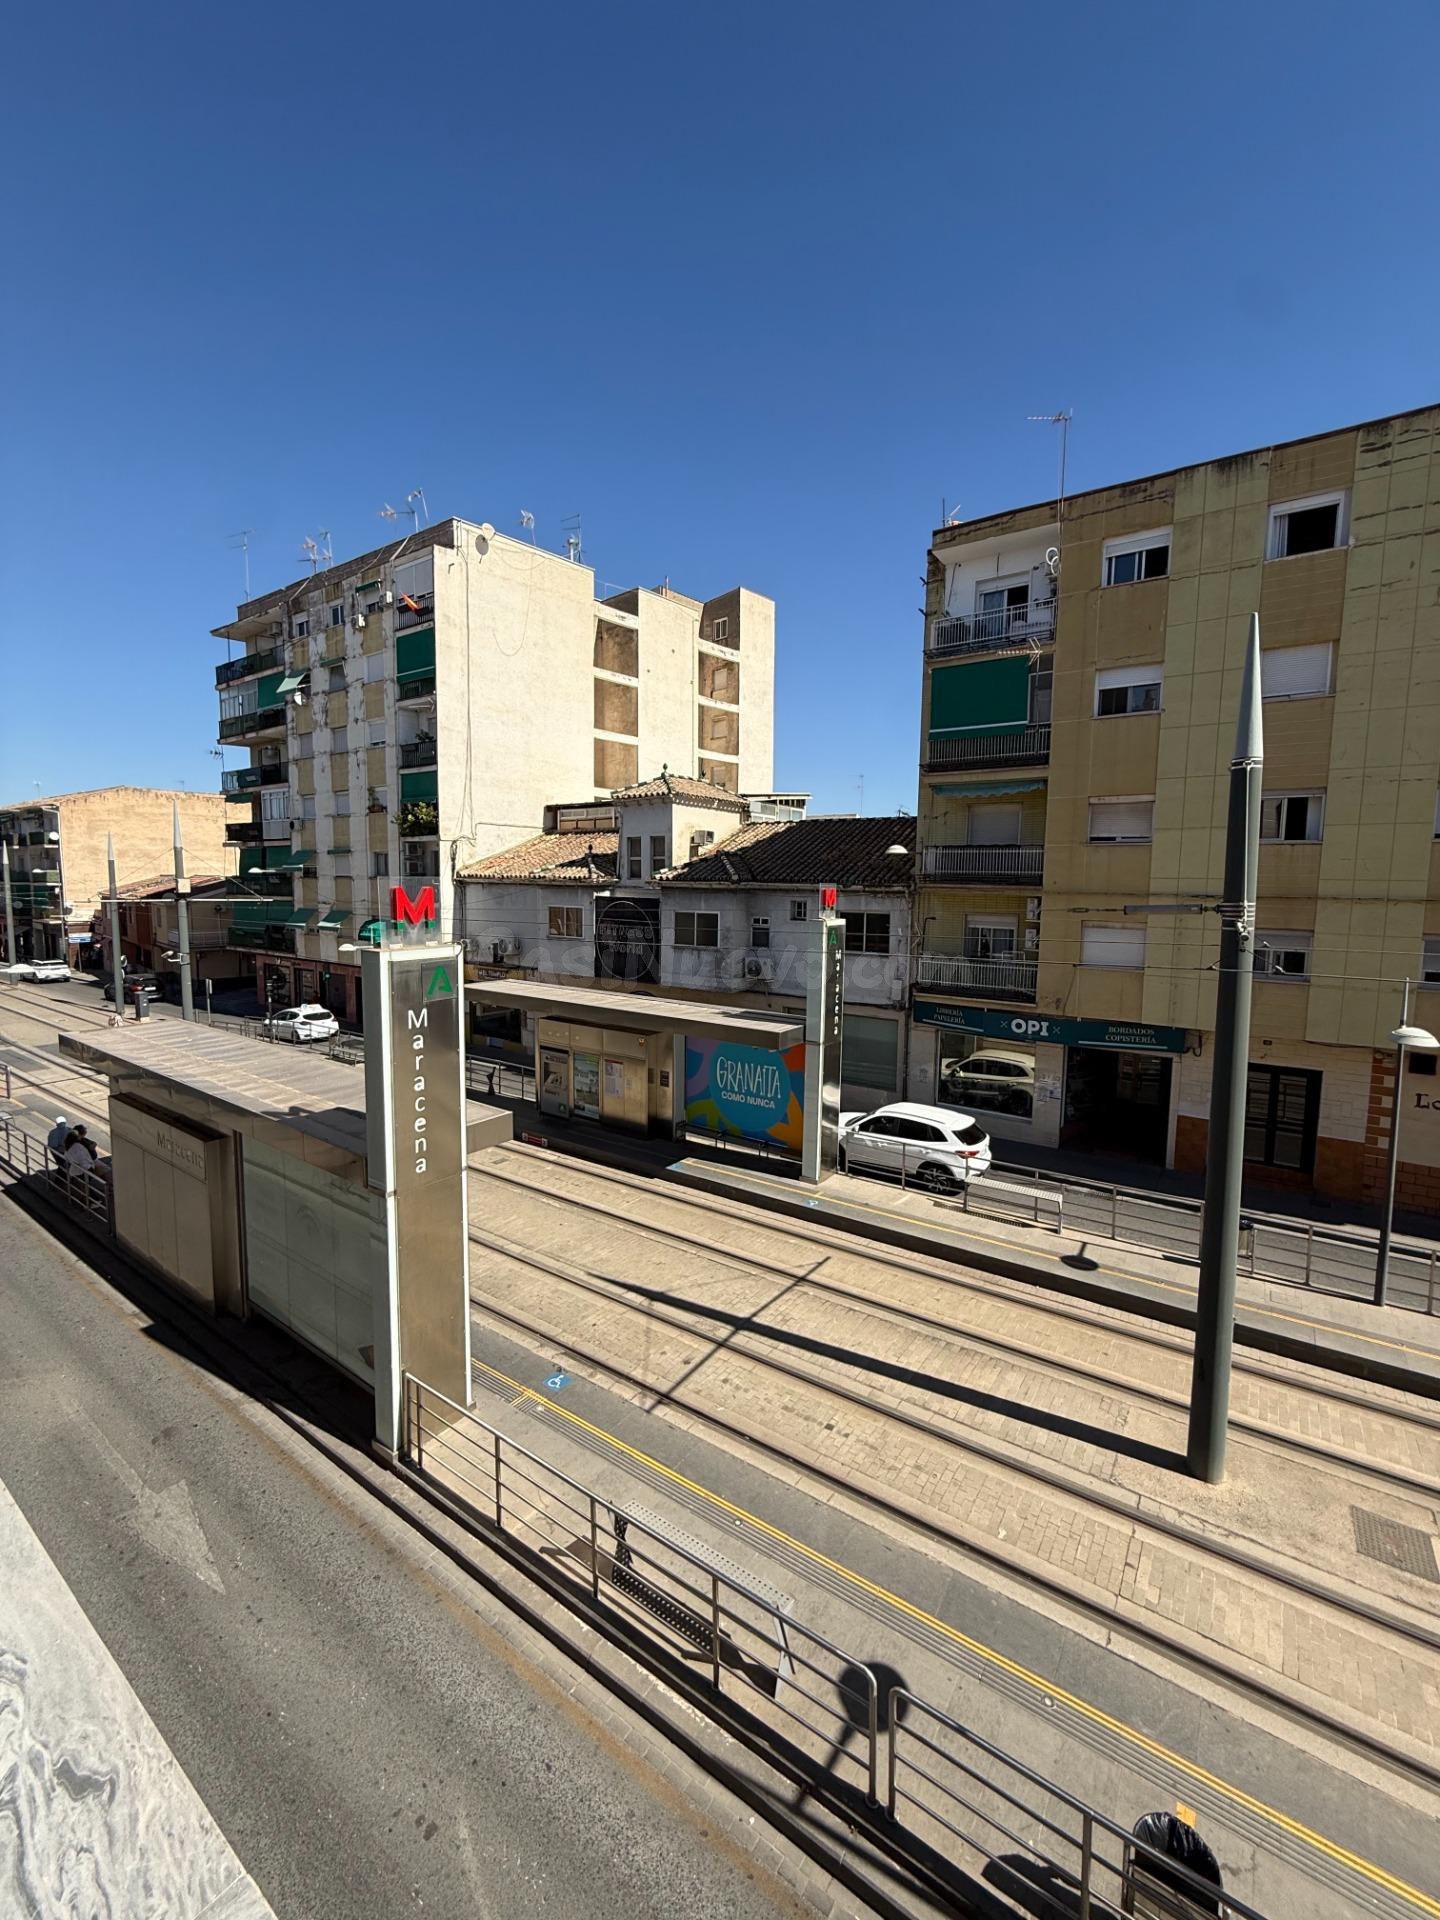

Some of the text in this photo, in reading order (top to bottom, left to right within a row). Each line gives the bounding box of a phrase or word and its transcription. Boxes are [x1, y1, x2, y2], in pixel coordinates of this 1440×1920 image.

[834, 950, 842, 1035] Maracena
[1010, 1018, 1049, 1037] OPI
[1108, 1025, 1155, 1036] BORDADOS
[1105, 1034, 1157, 1044] COPISTERÍA
[407, 1007, 429, 1174] Maracena
[721, 1090, 775, 1110] COMO NUNCA
